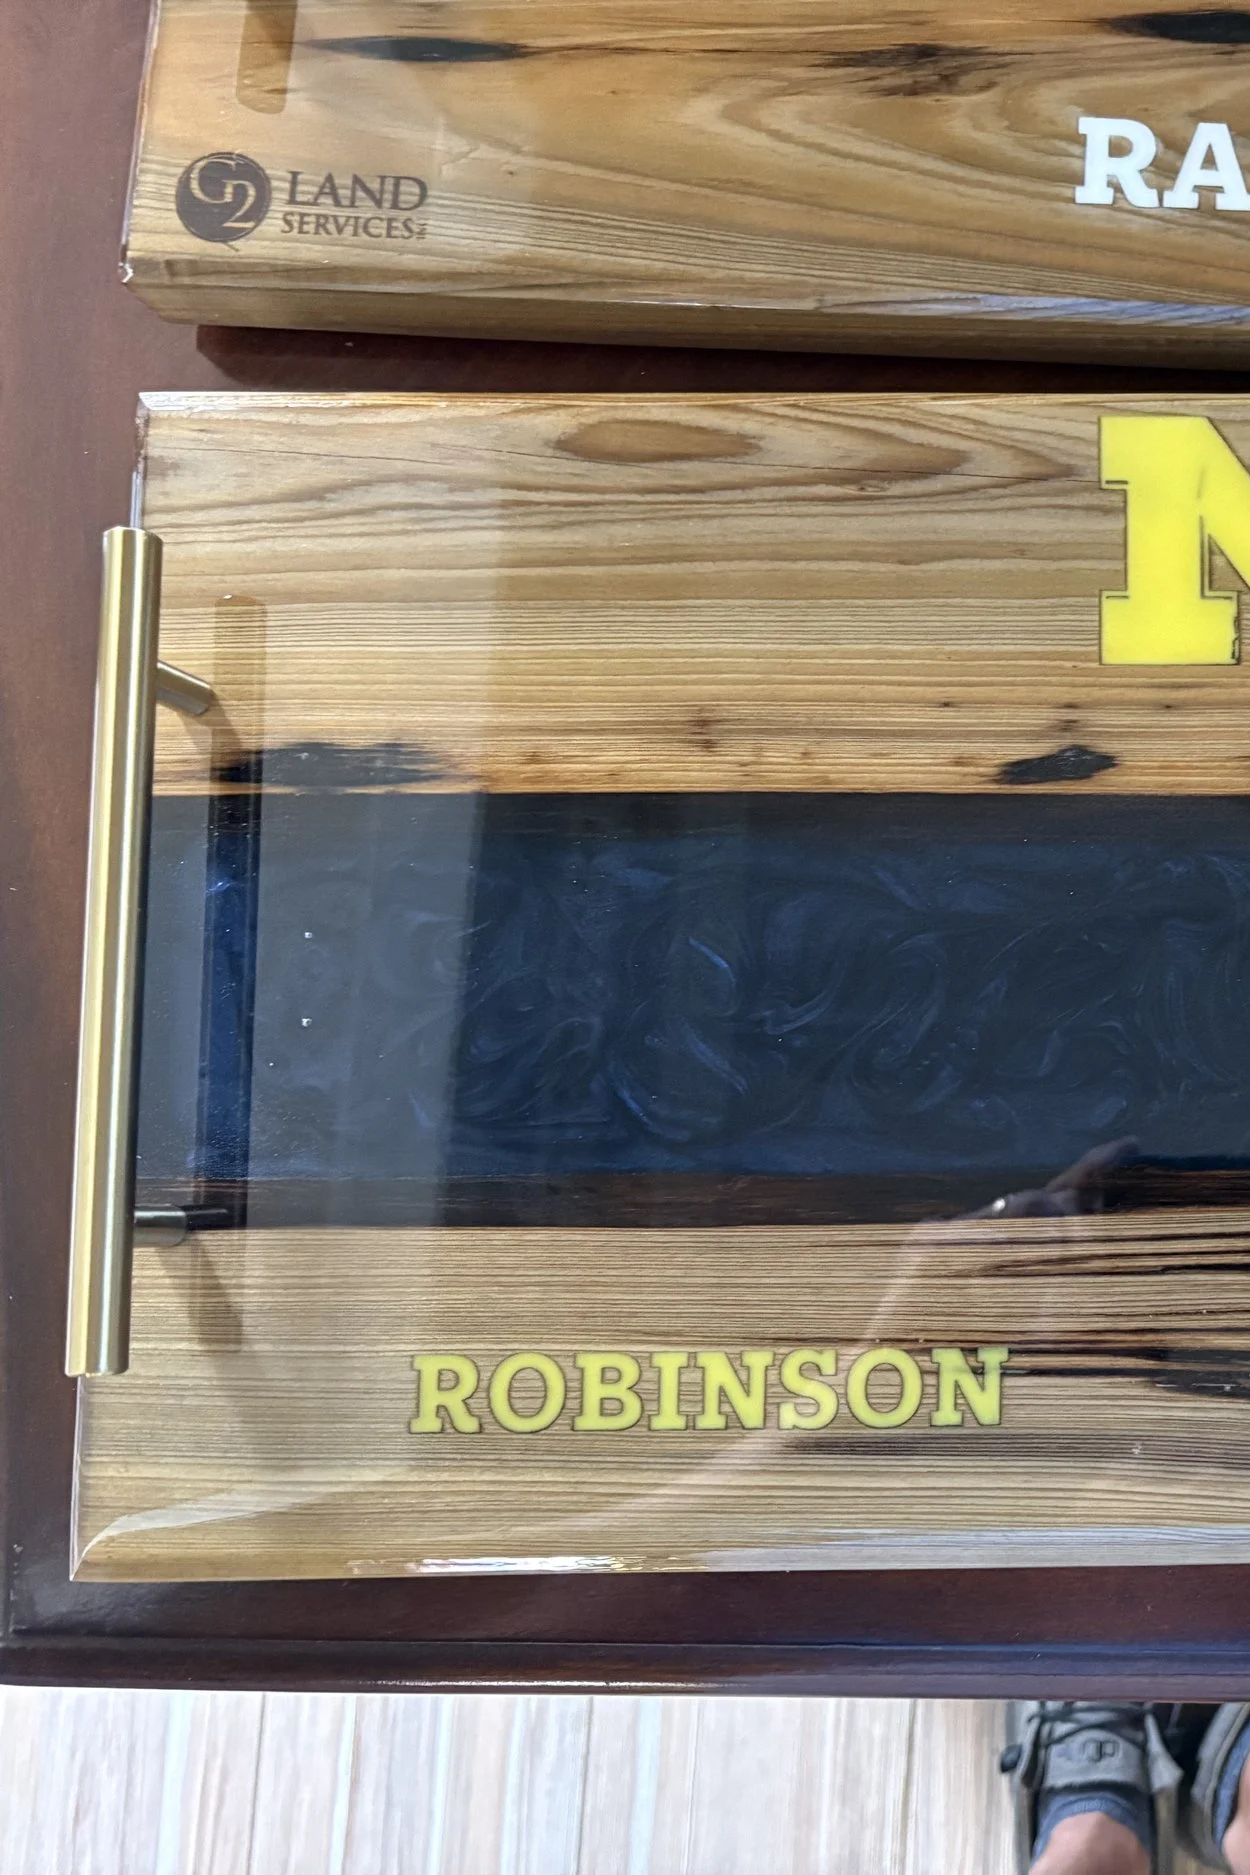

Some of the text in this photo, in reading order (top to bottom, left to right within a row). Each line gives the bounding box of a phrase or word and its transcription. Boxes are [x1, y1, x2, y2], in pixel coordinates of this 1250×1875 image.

[286, 170, 429, 212] LAND
[280, 211, 415, 240] SERVICES
[408, 1346, 1010, 1434] ROBINSON
